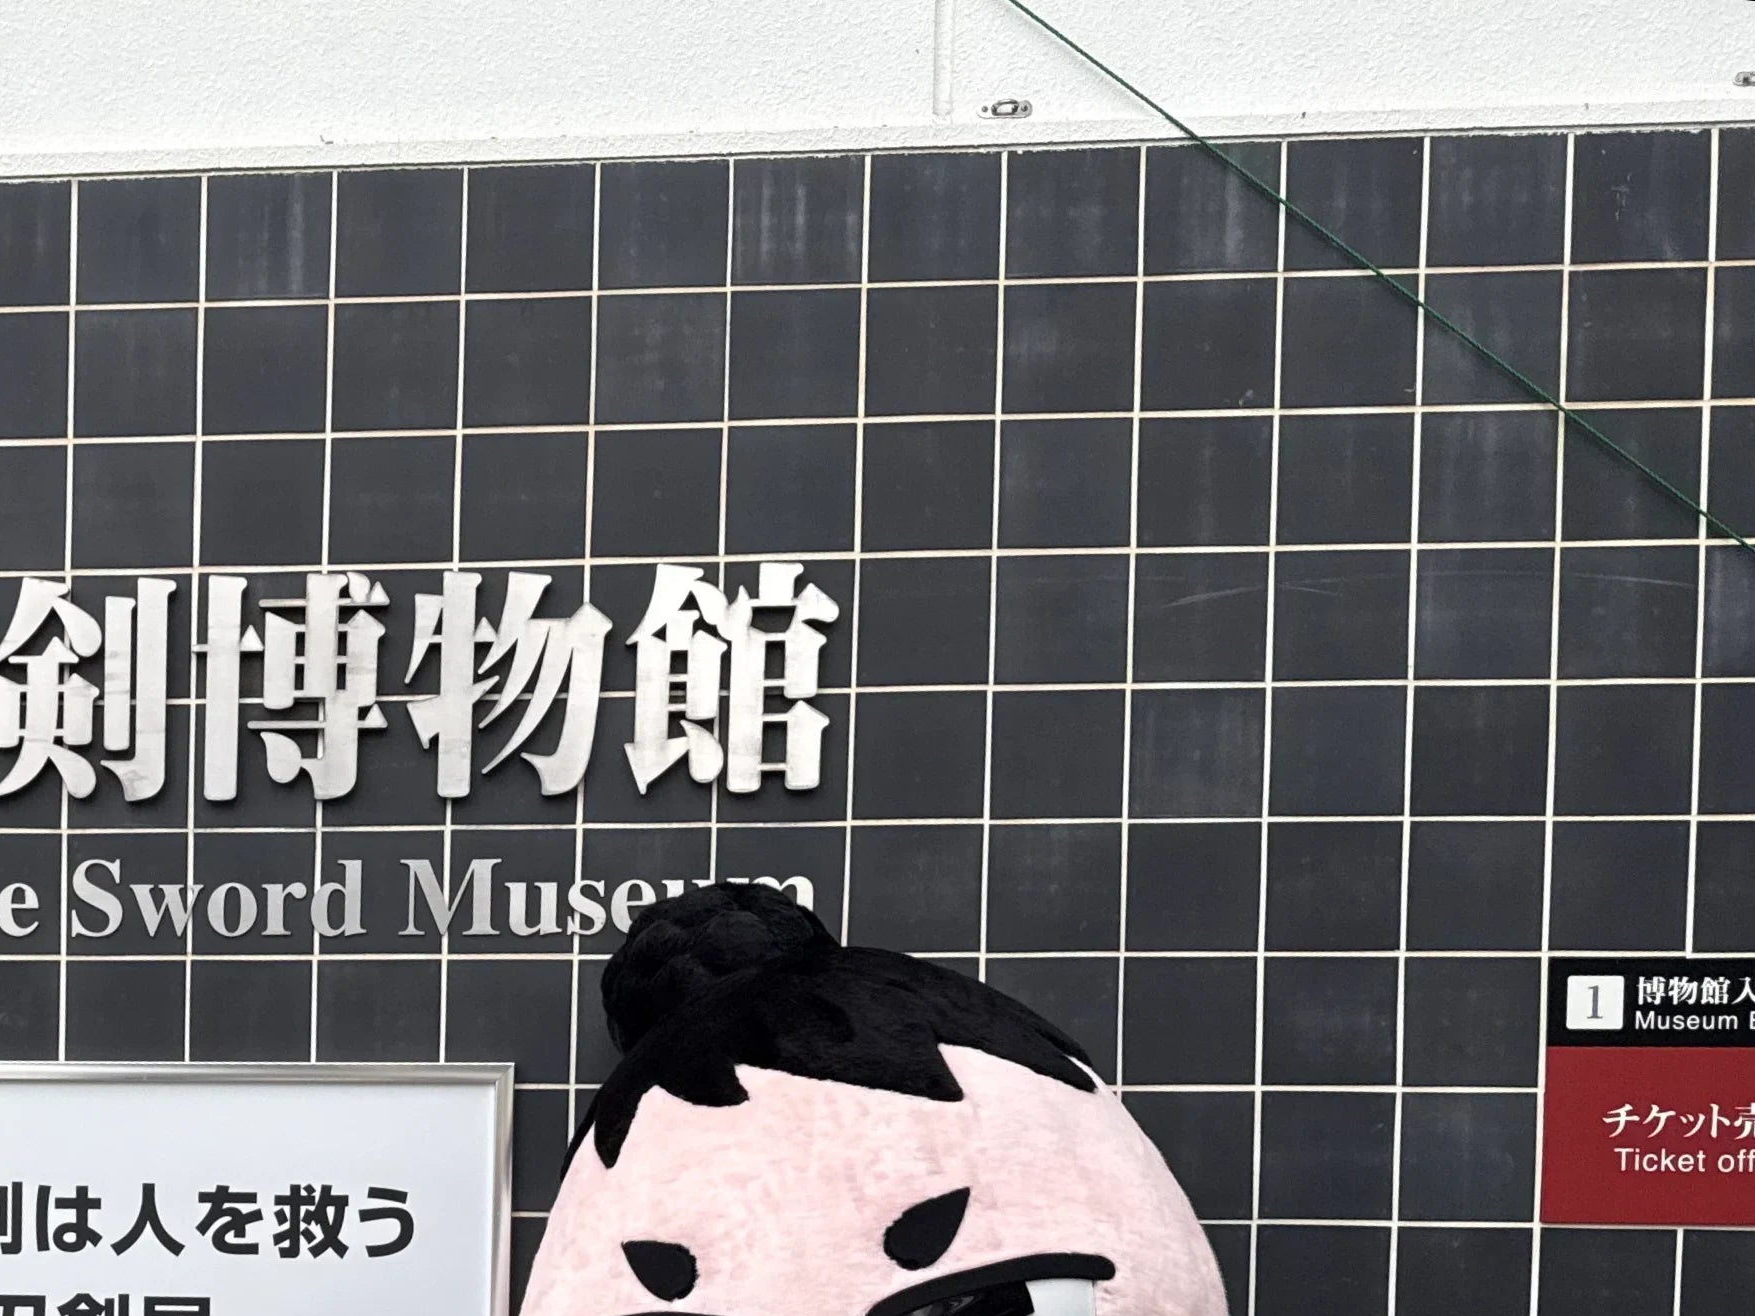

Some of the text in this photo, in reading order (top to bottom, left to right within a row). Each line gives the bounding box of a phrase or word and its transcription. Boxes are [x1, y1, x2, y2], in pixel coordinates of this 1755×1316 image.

[71, 858, 367, 939] Sword
[398, 857, 815, 937] Muse
[1586, 984, 1604, 1020] 1
[1634, 1010, 1739, 1030] Museum
[1614, 1147, 1706, 1173] Ticket
